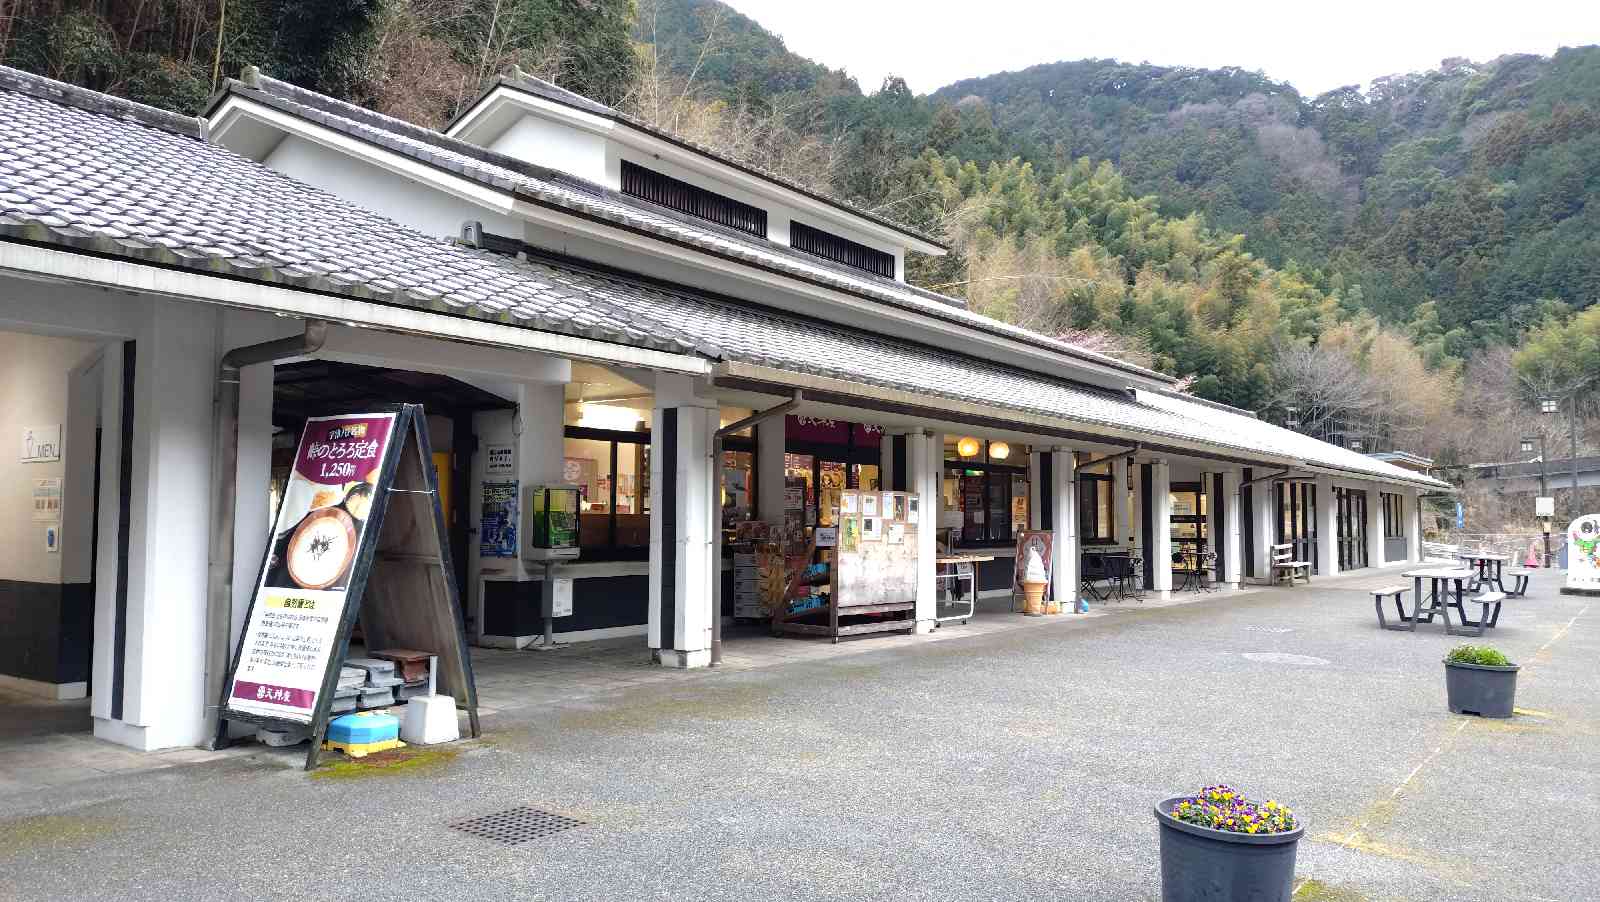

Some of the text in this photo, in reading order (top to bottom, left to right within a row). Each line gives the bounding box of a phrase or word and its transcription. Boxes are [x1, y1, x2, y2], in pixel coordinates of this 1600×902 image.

[307, 439, 379, 460] 峠のとろろ定食
[319, 462, 357, 477] 1,250円
